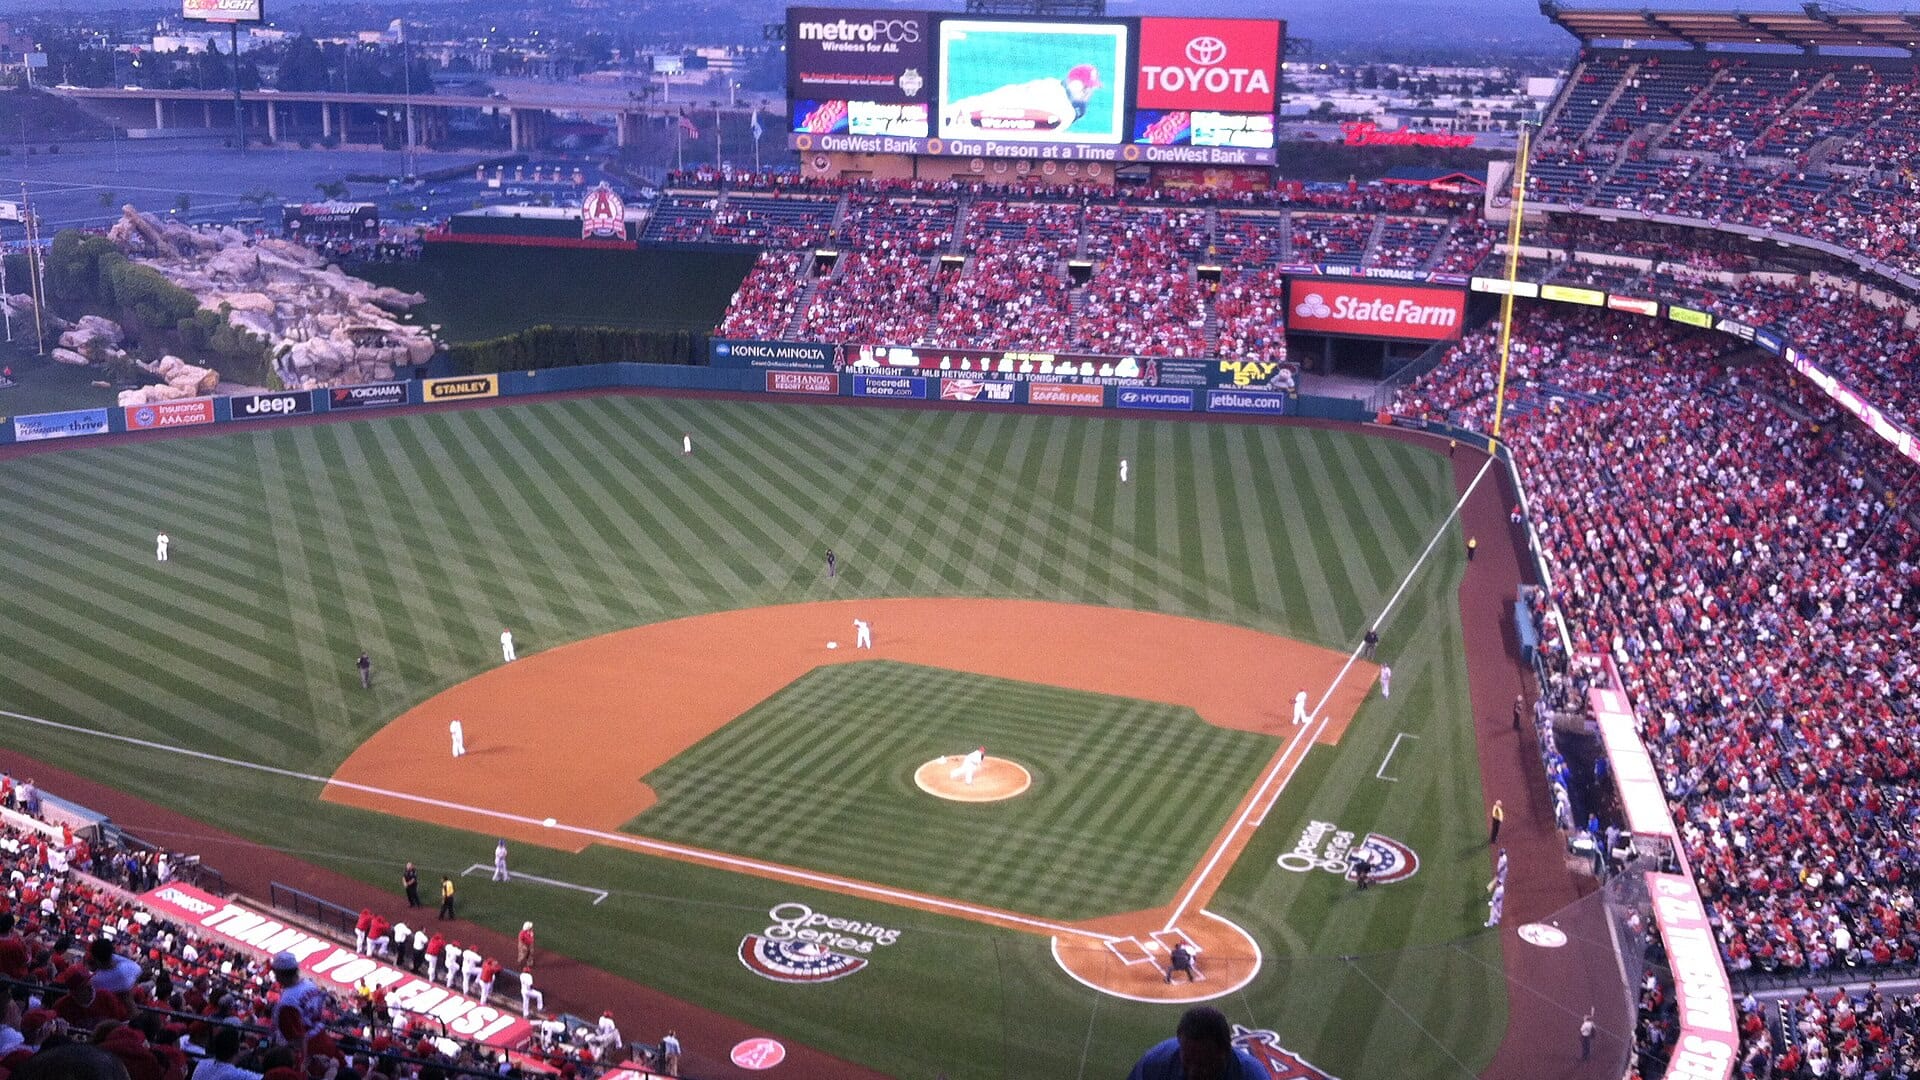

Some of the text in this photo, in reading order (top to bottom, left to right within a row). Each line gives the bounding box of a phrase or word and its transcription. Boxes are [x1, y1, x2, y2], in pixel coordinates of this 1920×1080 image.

[799, 19, 919, 43] metroPCS
[822, 42, 899, 53] Wireless for All.
[1141, 66, 1270, 94] TOYOTA
[821, 135, 918, 152] OneWest Bank
[950, 141, 1116, 160] One Person at a Time
[1146, 146, 1208, 161] OneWest
[1211, 148, 1245, 163] Bank
[1325, 265, 1350, 276] MINI
[1366, 268, 1414, 280] STORAGE
[731, 345, 825, 360] KONICA MINOLTA
[845, 365, 903, 376] MLB TONIGHT
[1220, 360, 1277, 374] MAY
[774, 374, 831, 385] PECHANGA
[922, 370, 984, 380] MLB NETWORK
[1004, 373, 1063, 383] MLB TONIGHT
[1082, 377, 1145, 387] MLB NETWORK
[1234, 371, 1265, 386] 5TH
[350, 386, 401, 398] YOKOHAMA
[435, 382, 487, 395] STANLEY
[1032, 391, 1100, 403] SAFARI PARK
[1140, 394, 1190, 404] HYUNDAI
[1210, 395, 1281, 409] jetblue.com
[159, 403, 205, 414] Insurance
[246, 396, 296, 414] Jeep
[160, 413, 206, 424] AAA.com
[769, 902, 901, 945] Opening
[200, 903, 516, 1042] THANK YOU FANS!
